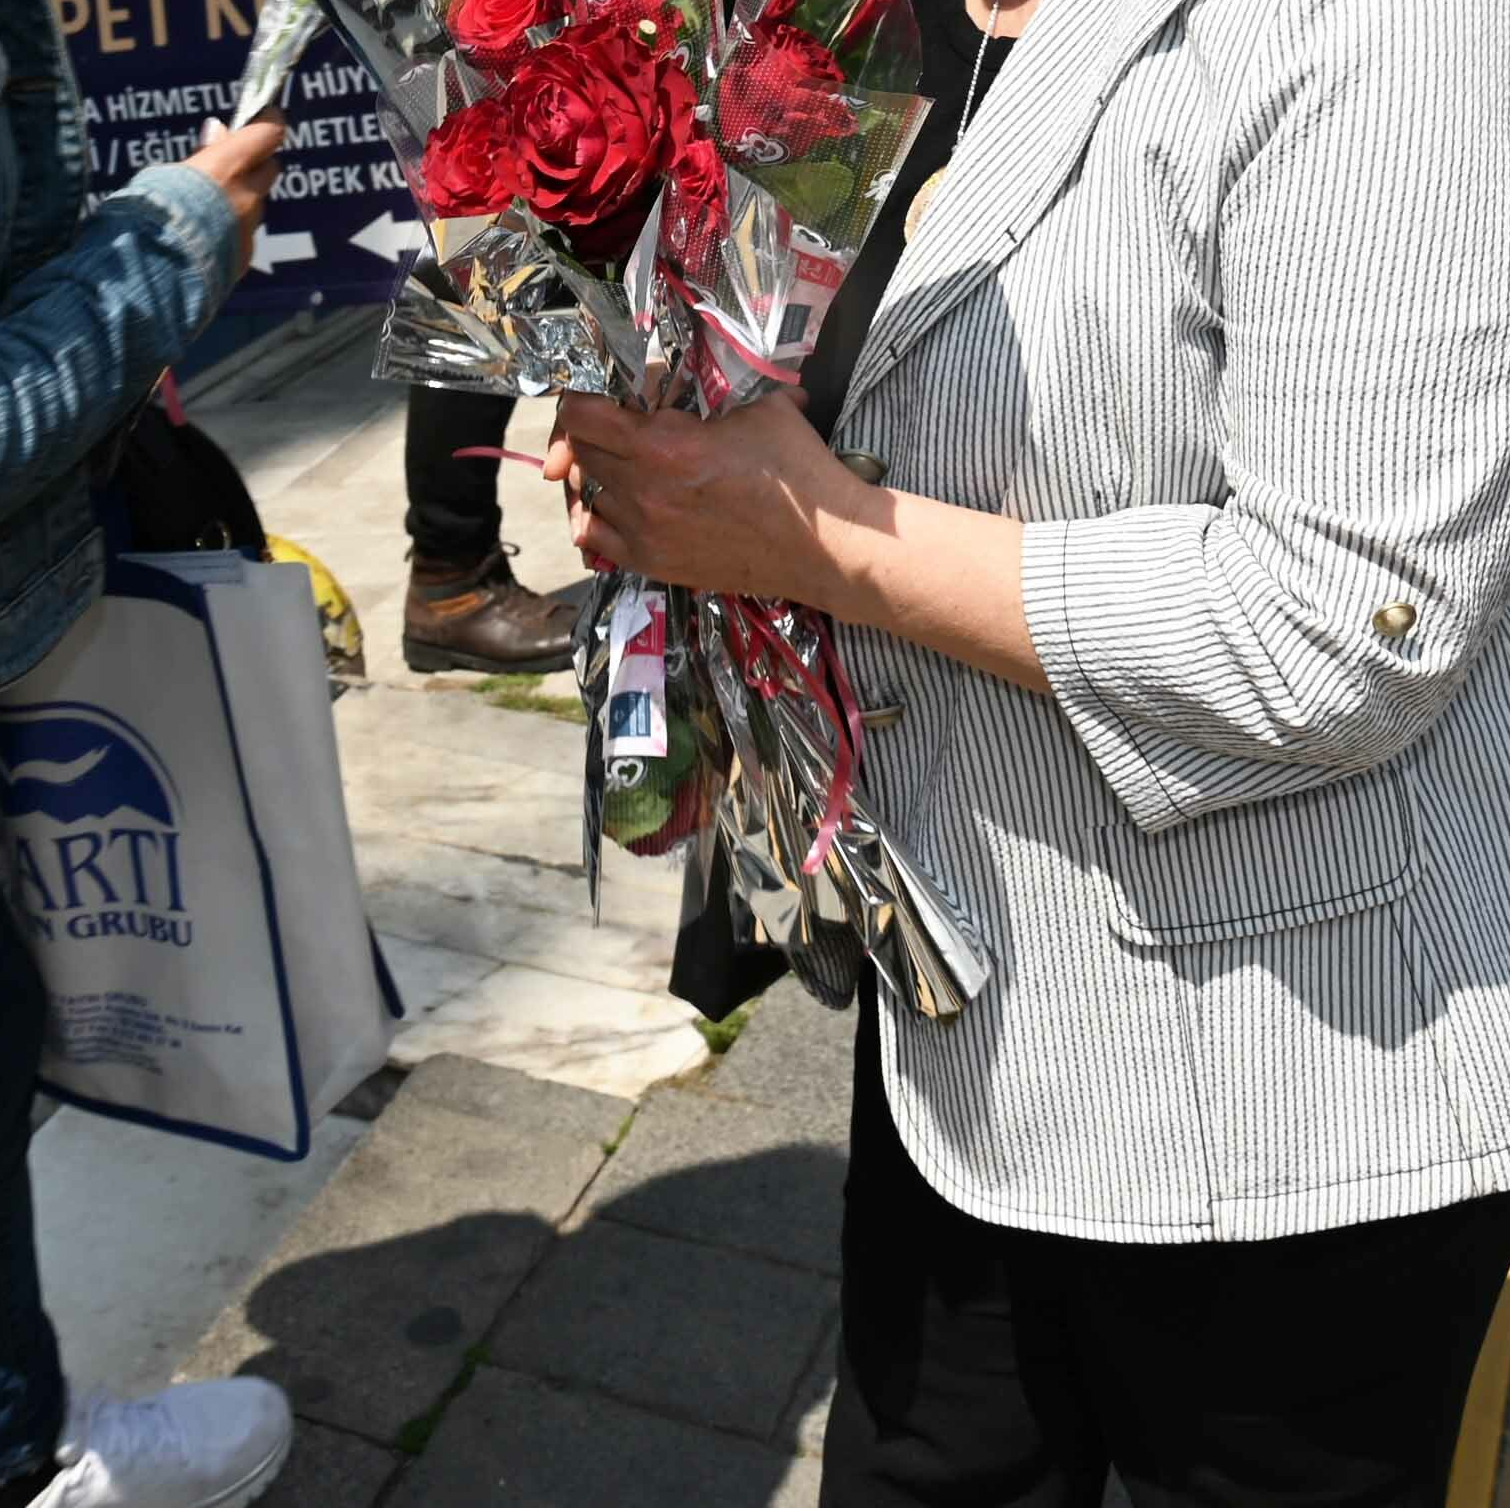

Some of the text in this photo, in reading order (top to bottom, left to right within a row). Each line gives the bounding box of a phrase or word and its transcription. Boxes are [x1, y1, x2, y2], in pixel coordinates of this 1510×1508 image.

[276, 113, 388, 152] METLE
[269, 163, 366, 203] KÖPEK
[13, 828, 187, 912] ARTI
[68, 911, 193, 948] GRUBU
